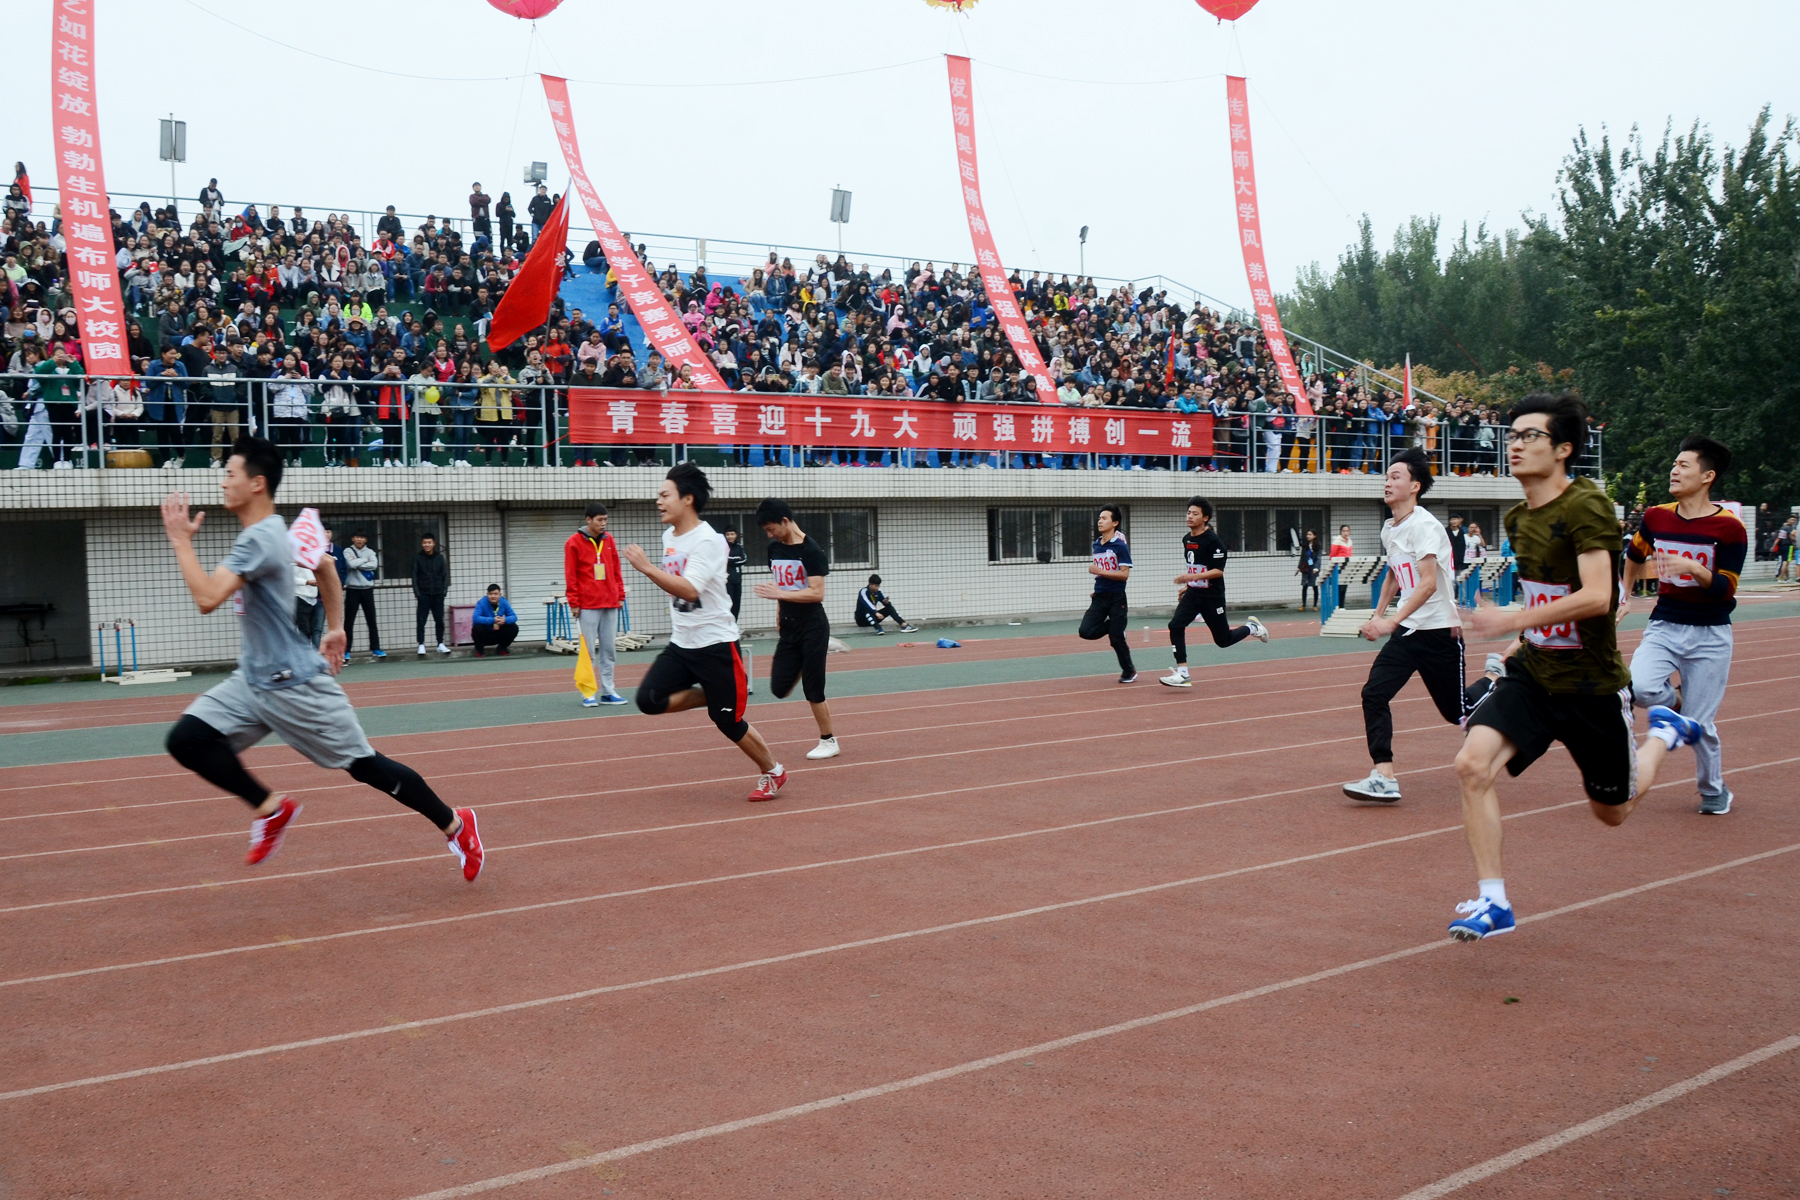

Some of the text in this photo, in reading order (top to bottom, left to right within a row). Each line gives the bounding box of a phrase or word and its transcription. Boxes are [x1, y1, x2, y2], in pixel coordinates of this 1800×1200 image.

[61, 125, 122, 360] 勃勃生机遍布师大校园
[950, 76, 988, 236] 发扬奥运精神
[1229, 97, 1306, 403] 传承师大学风 养我浩然正气
[606, 400, 1192, 448] 青春喜迎十九大 顽强拼搏创一流
